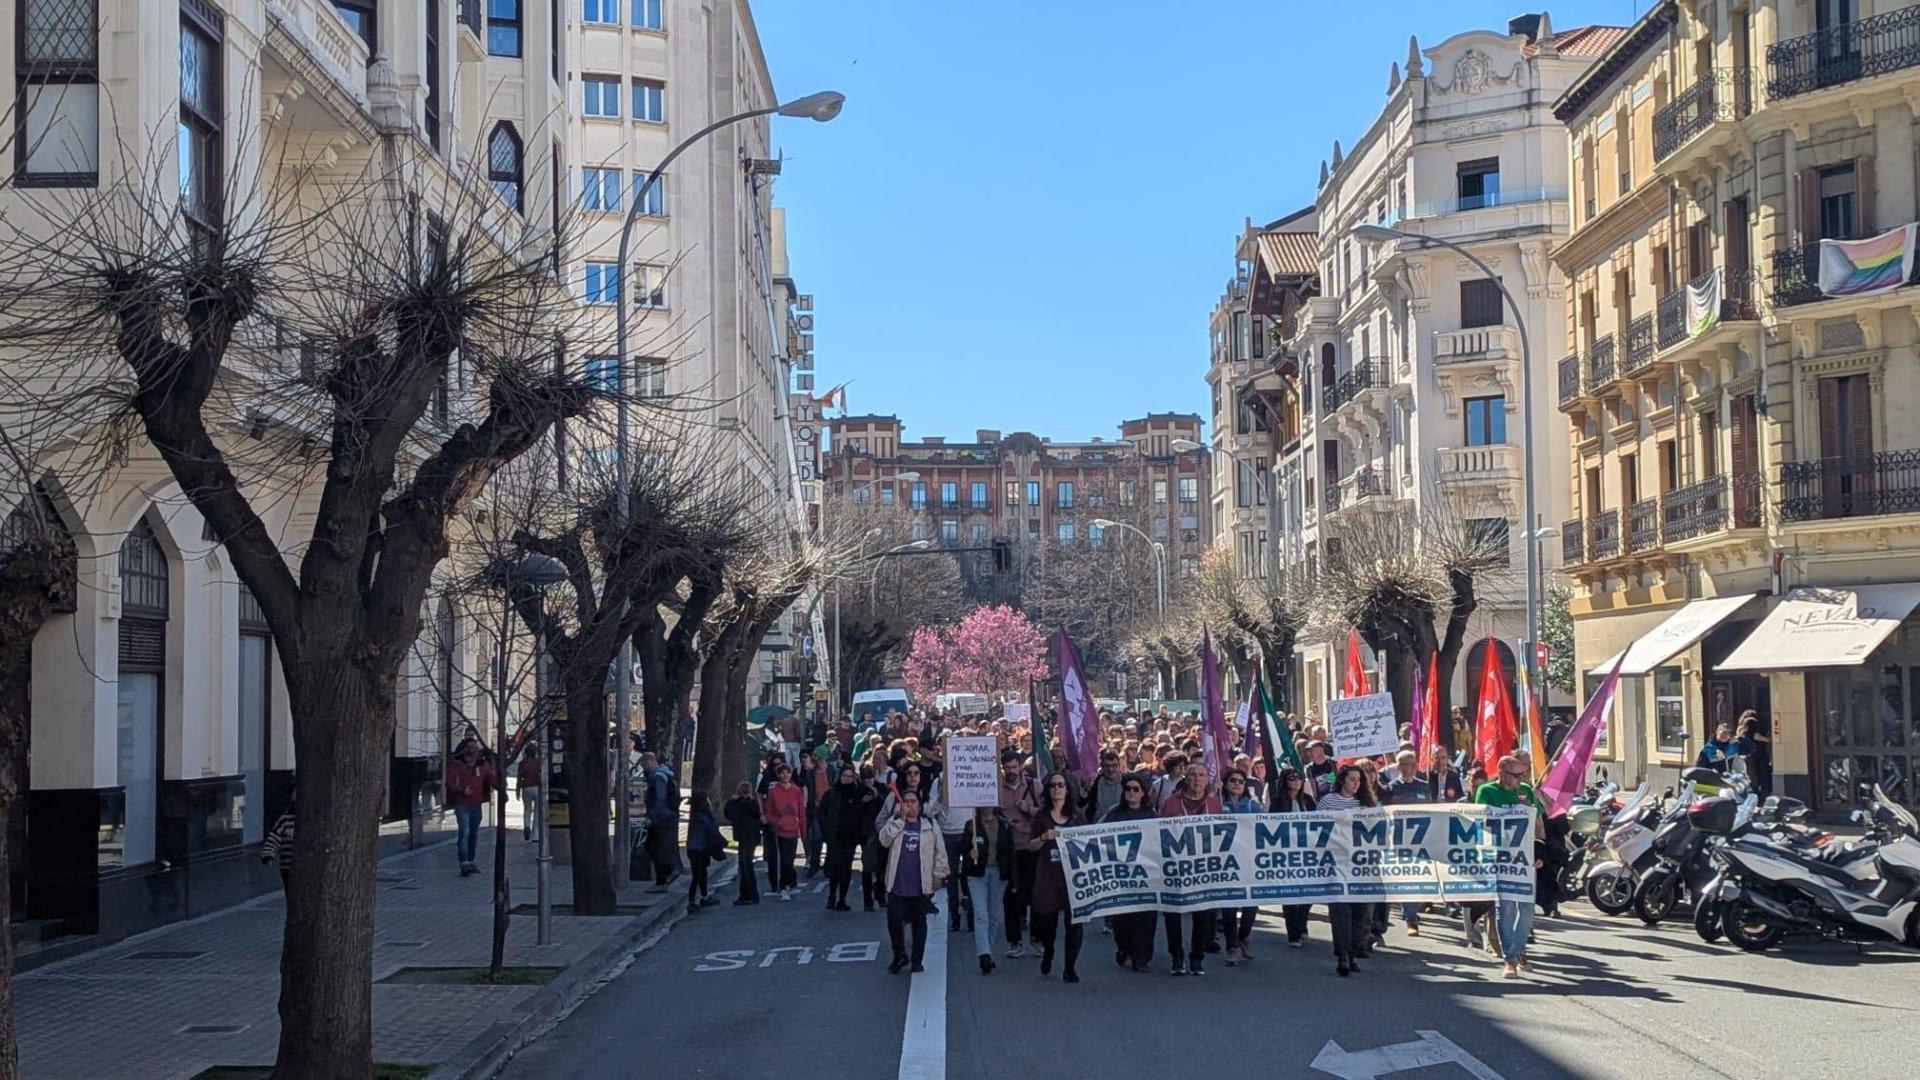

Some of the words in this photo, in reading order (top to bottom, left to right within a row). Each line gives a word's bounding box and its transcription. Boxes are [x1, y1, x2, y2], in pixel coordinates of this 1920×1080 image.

[798, 295, 813, 390] HOTEL
[798, 405, 813, 500] YOLDI
[1107, 824, 1140, 833] GENERAL
[1173, 816, 1203, 825] HUELGA
[1160, 823, 1238, 858] M17
[1255, 821, 1335, 850] M17
[1352, 817, 1431, 847] M17
[1449, 816, 1529, 848] M17
[1065, 832, 1143, 870] M17
[1254, 850, 1337, 869] GREBA
[1351, 848, 1433, 866] GREBA
[1447, 848, 1529, 866] GREBA
[1072, 864, 1149, 889] GREBA
[1162, 854, 1240, 877] GREBA
[1254, 867, 1337, 880] OROKORRA
[1351, 866, 1432, 877] OROKORRA
[1448, 865, 1528, 877] OROKORRA
[1075, 880, 1149, 901] OROKORRA
[1163, 872, 1240, 888] OROKORRA
[693, 941, 881, 972] BUS
